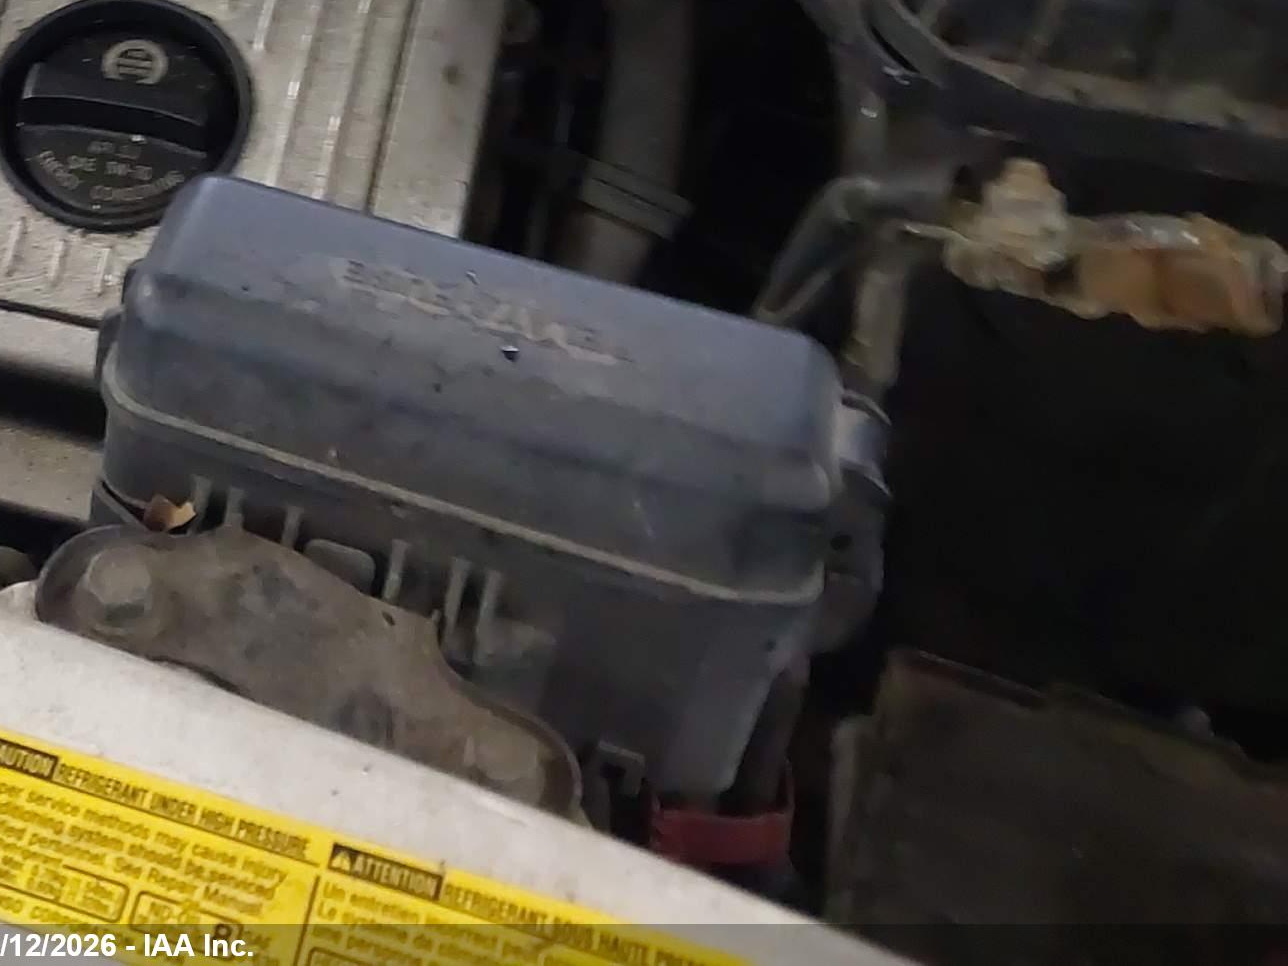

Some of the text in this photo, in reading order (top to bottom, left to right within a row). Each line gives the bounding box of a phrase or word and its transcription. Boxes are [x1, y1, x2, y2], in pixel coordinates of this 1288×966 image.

[27, 791, 80, 816] service
[83, 809, 150, 838] methods
[154, 832, 188, 853] may
[192, 844, 237, 866] cause
[56, 764, 146, 805] REFRIGERANT
[150, 794, 195, 820] UNDER
[199, 809, 233, 833] HIGH
[235, 821, 307, 857] PRESSURE
[355, 856, 437, 896] ATTENTION
[442, 885, 547, 933] REFRIGERANT
